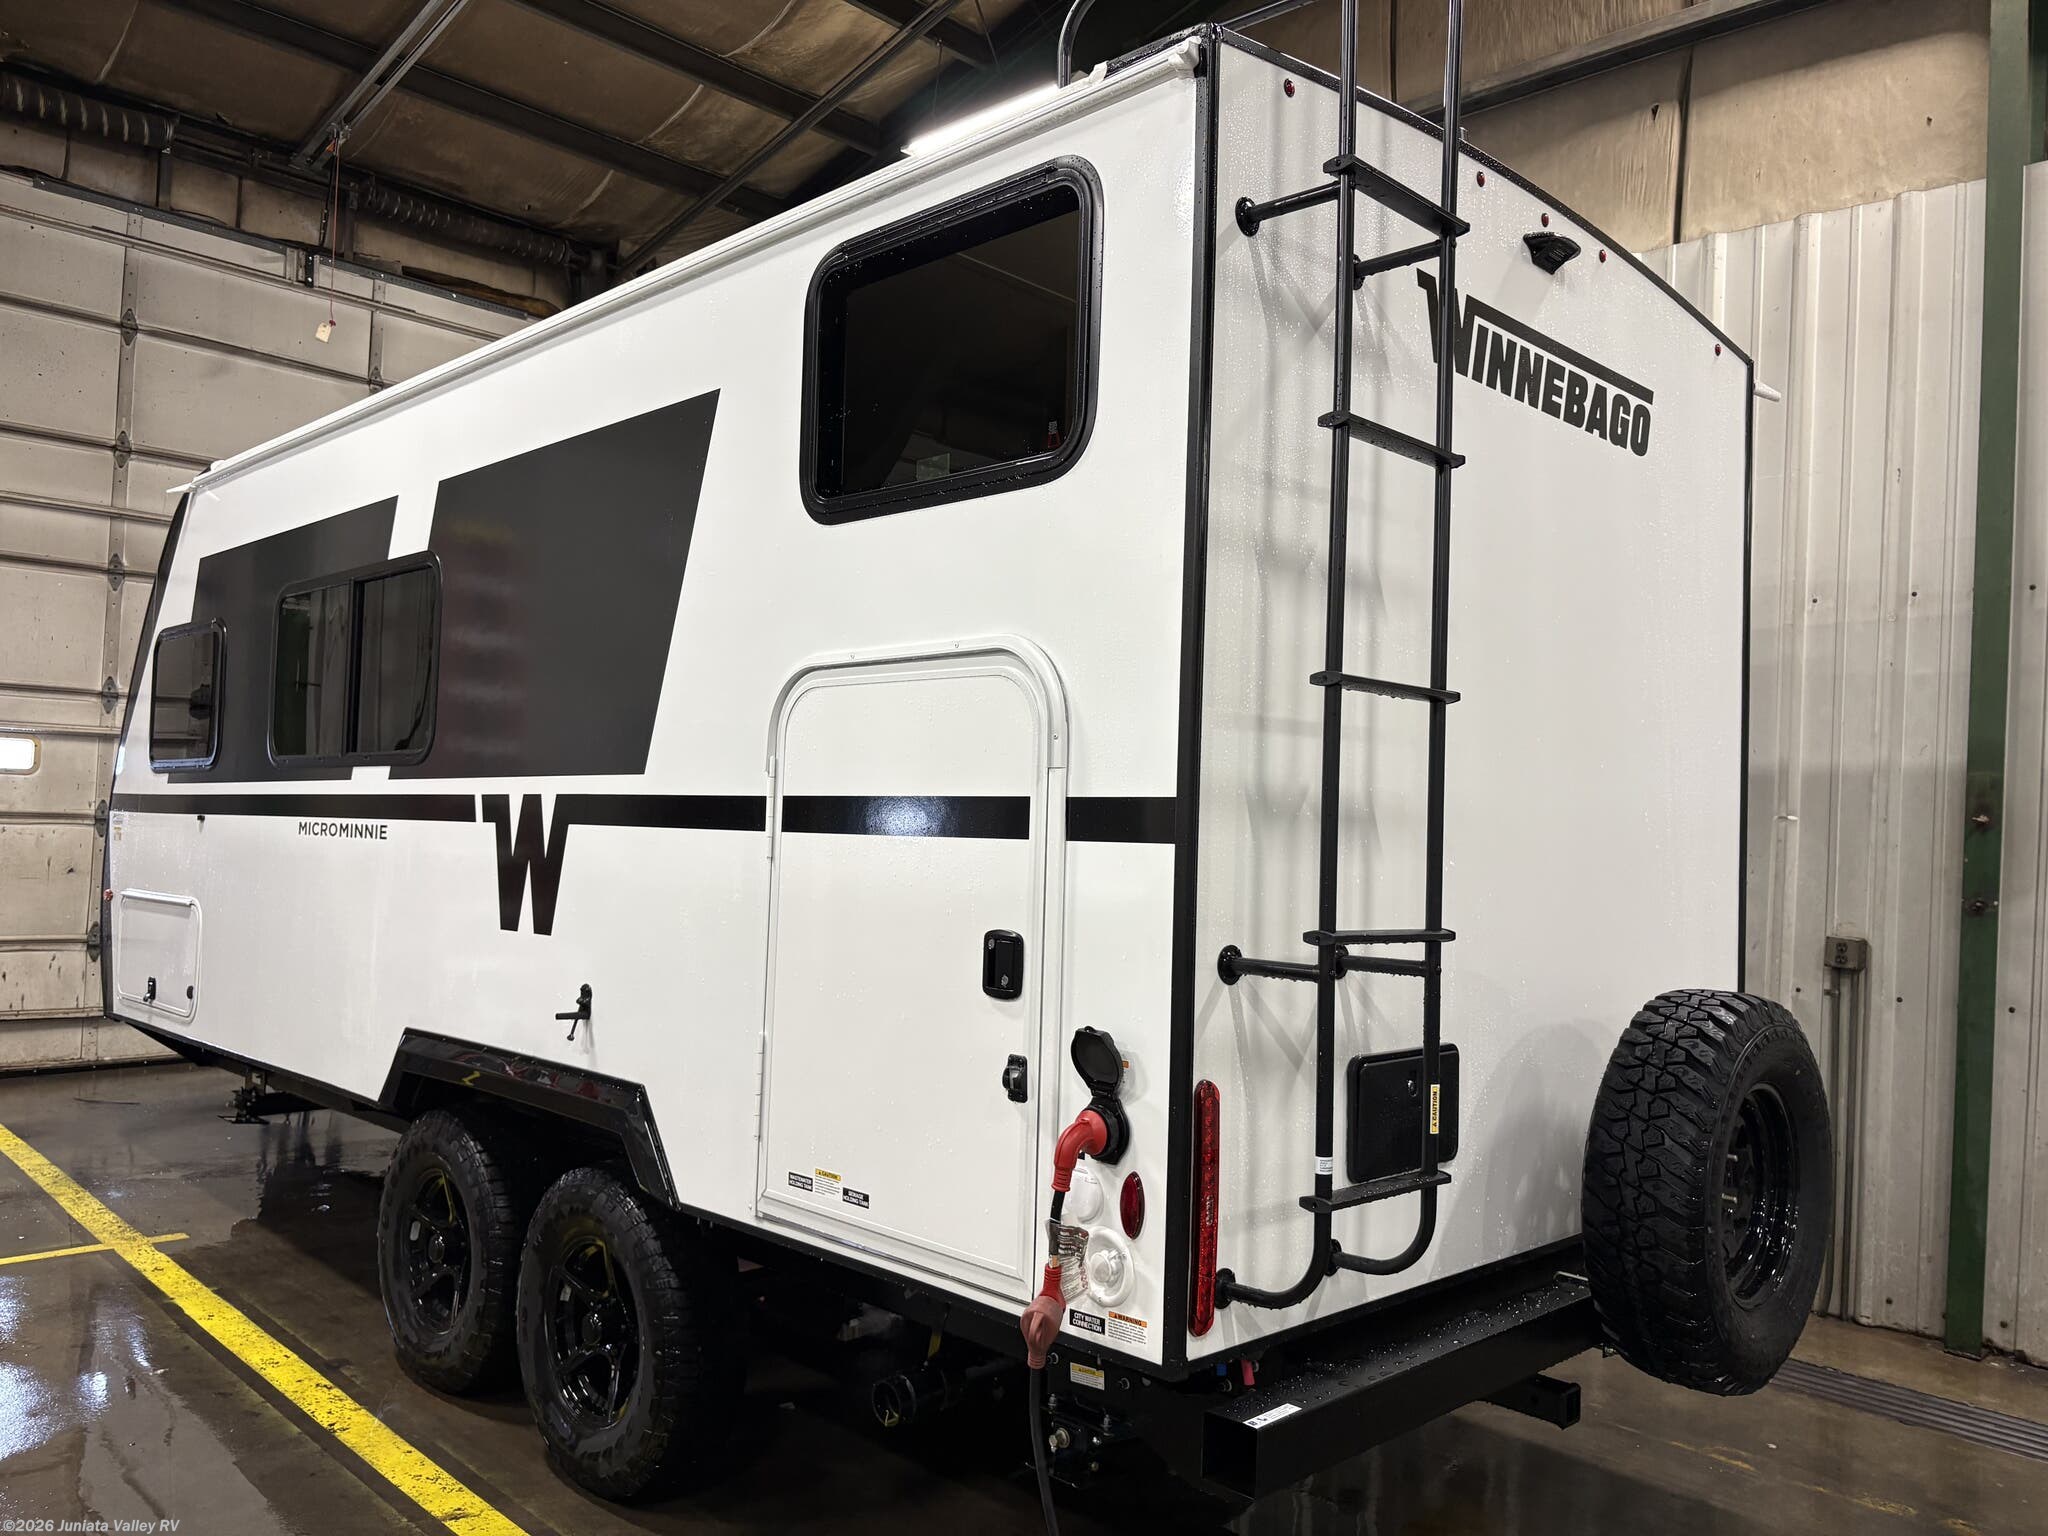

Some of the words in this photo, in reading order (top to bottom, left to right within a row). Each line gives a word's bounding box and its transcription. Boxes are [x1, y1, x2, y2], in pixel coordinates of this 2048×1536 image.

[1416, 267, 1654, 457] WINNEBAGO
[298, 821, 388, 840] MICROMINNIE
[481, 794, 570, 937] W
[1072, 1319, 1102, 1333] CONNECTION
[1073, 1312, 1084, 1321] CITY
[1084, 1314, 1101, 1325] WATER
[1118, 1313, 1142, 1326] WARNING
